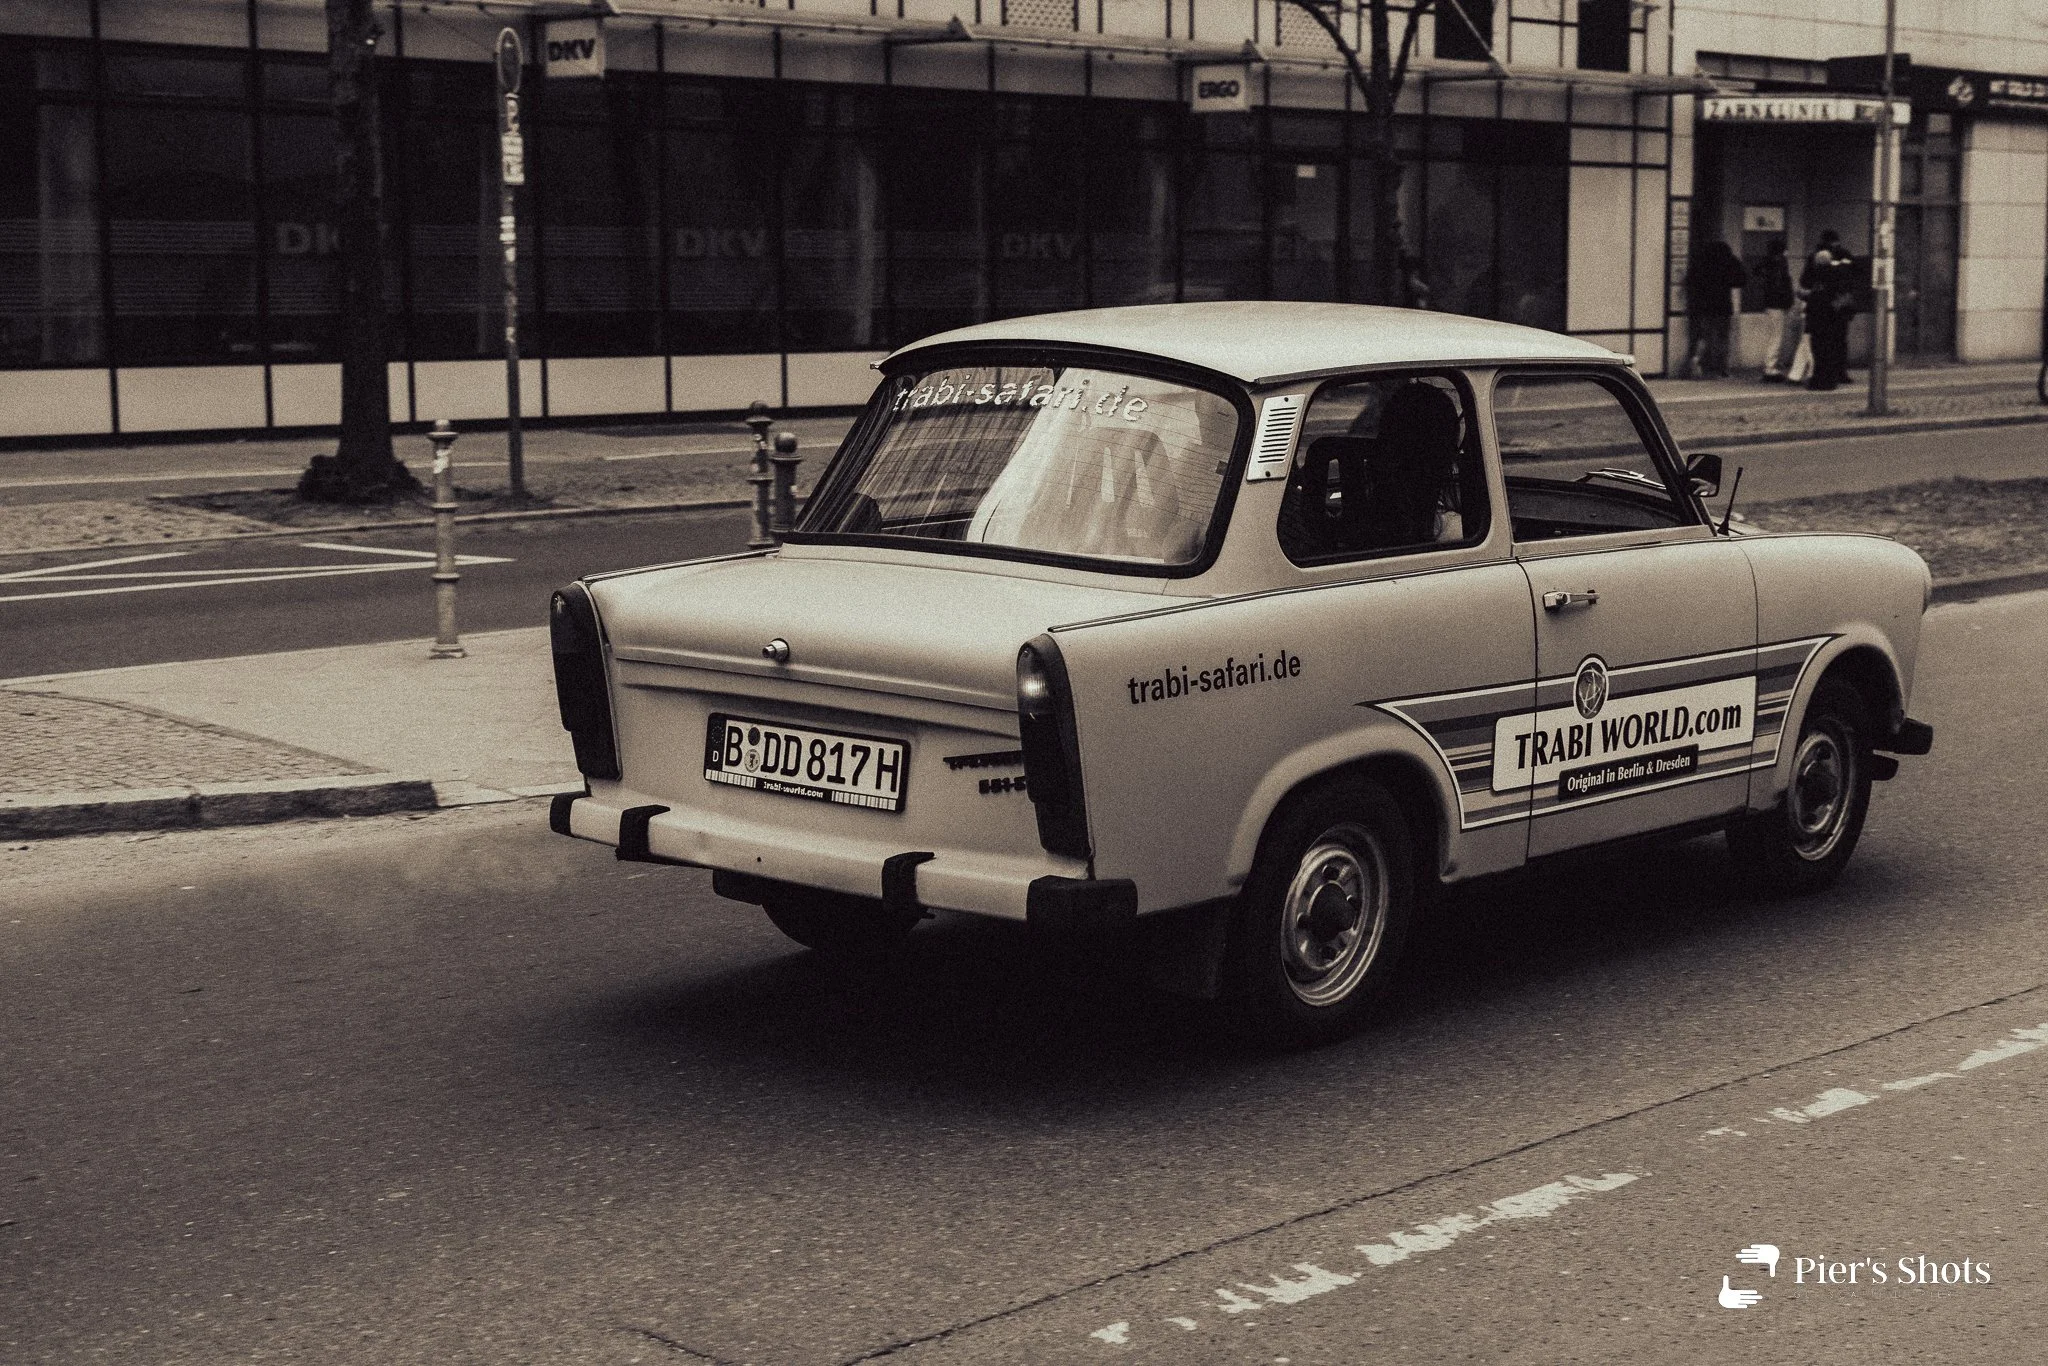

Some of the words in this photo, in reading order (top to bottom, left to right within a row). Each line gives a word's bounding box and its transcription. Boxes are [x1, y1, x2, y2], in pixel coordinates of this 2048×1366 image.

[548, 37, 596, 62] DKV
[1199, 80, 1240, 100] ERGO
[676, 226, 766, 257] DKV
[1002, 231, 1078, 259] DKV
[892, 374, 1149, 421] trabi-safari.de
[1127, 649, 1301, 705] trabi-safari.de
[1515, 722, 1593, 770] TRABI
[1600, 704, 1741, 754] WORLD.com
[712, 750, 719, 762] D
[1567, 769, 1604, 793] Original
[1606, 768, 1616, 783] in
[1617, 762, 1645, 780] Berlin
[1646, 761, 1654, 775] &
[1656, 754, 1691, 773] Dresden
[763, 781, 824, 798] trabi-world.com
